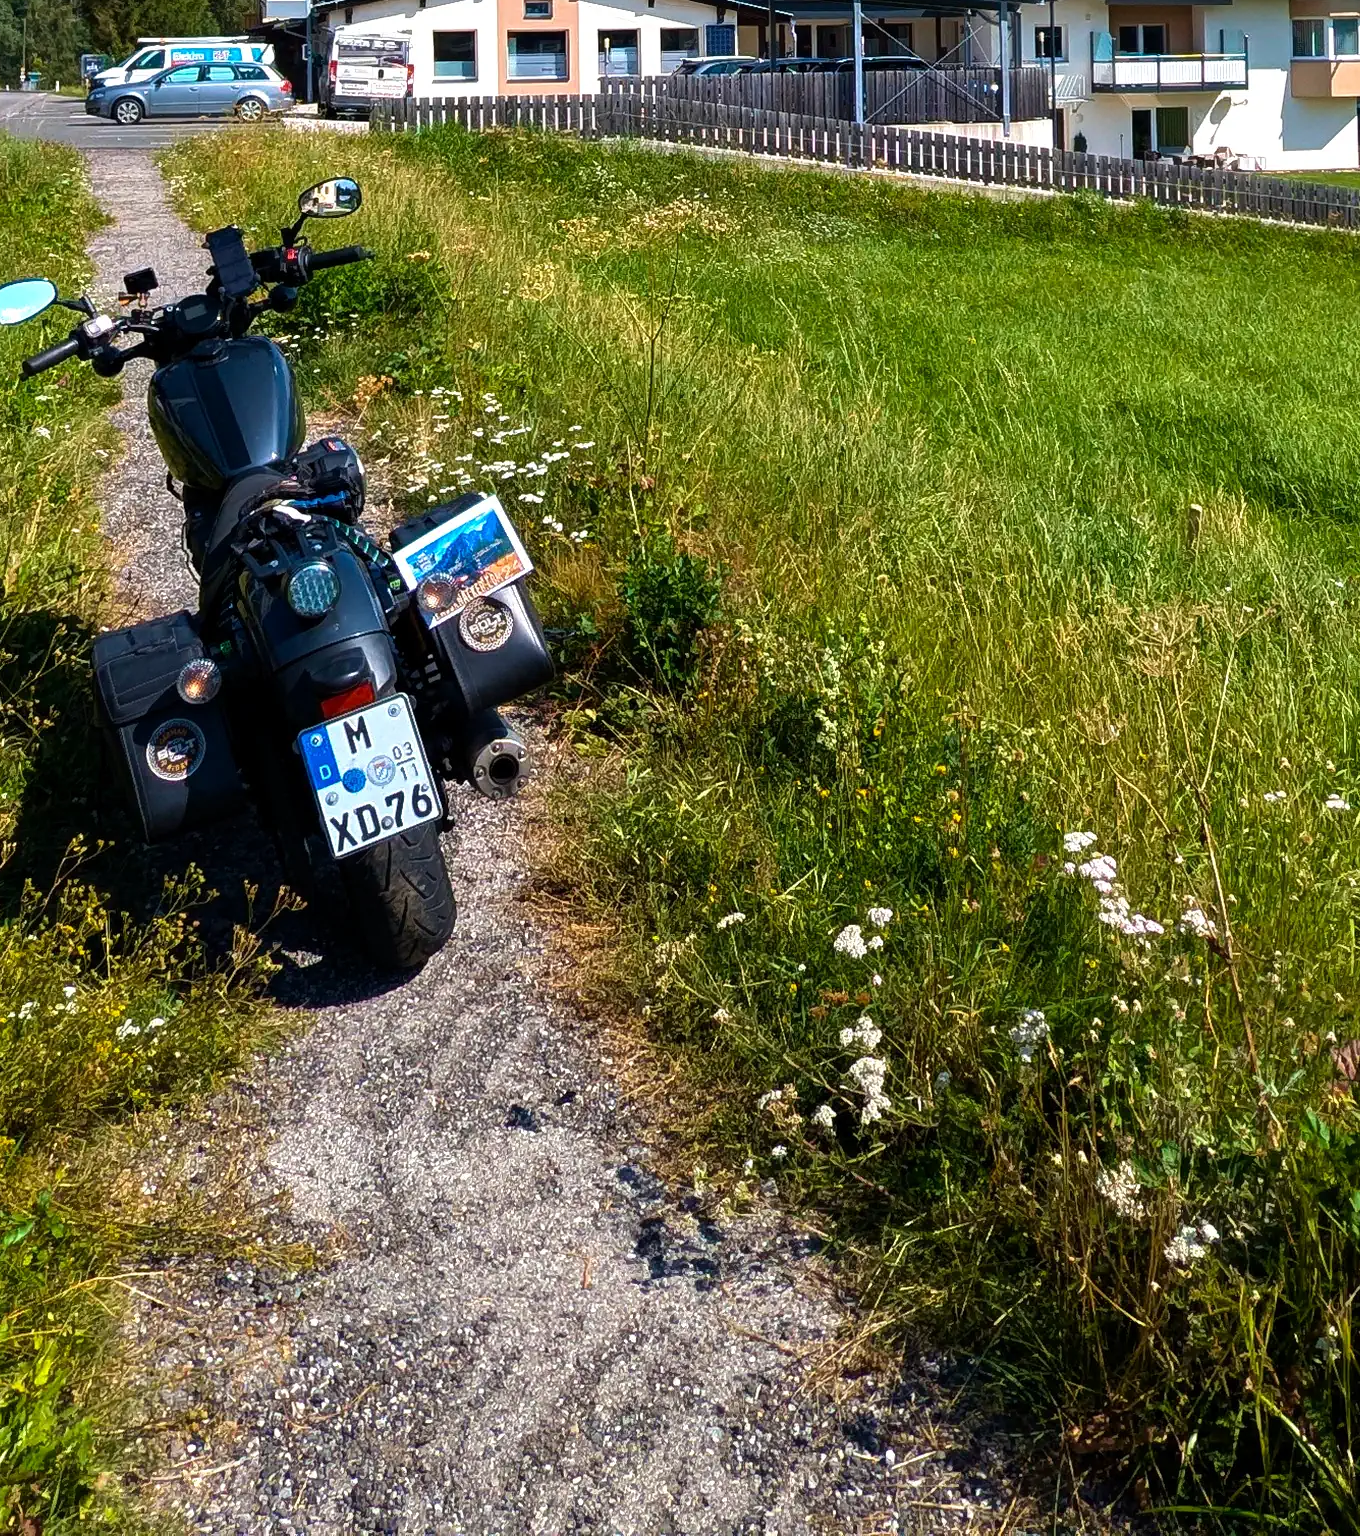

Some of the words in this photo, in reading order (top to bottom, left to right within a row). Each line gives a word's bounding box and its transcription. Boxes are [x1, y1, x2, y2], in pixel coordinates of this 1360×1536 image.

[468, 612, 504, 635] BOLT
[342, 715, 372, 755] M
[392, 741, 414, 761] 03
[318, 764, 332, 781] D
[399, 762, 419, 781] 11
[329, 803, 381, 853] XD
[384, 783, 434, 828] 76
